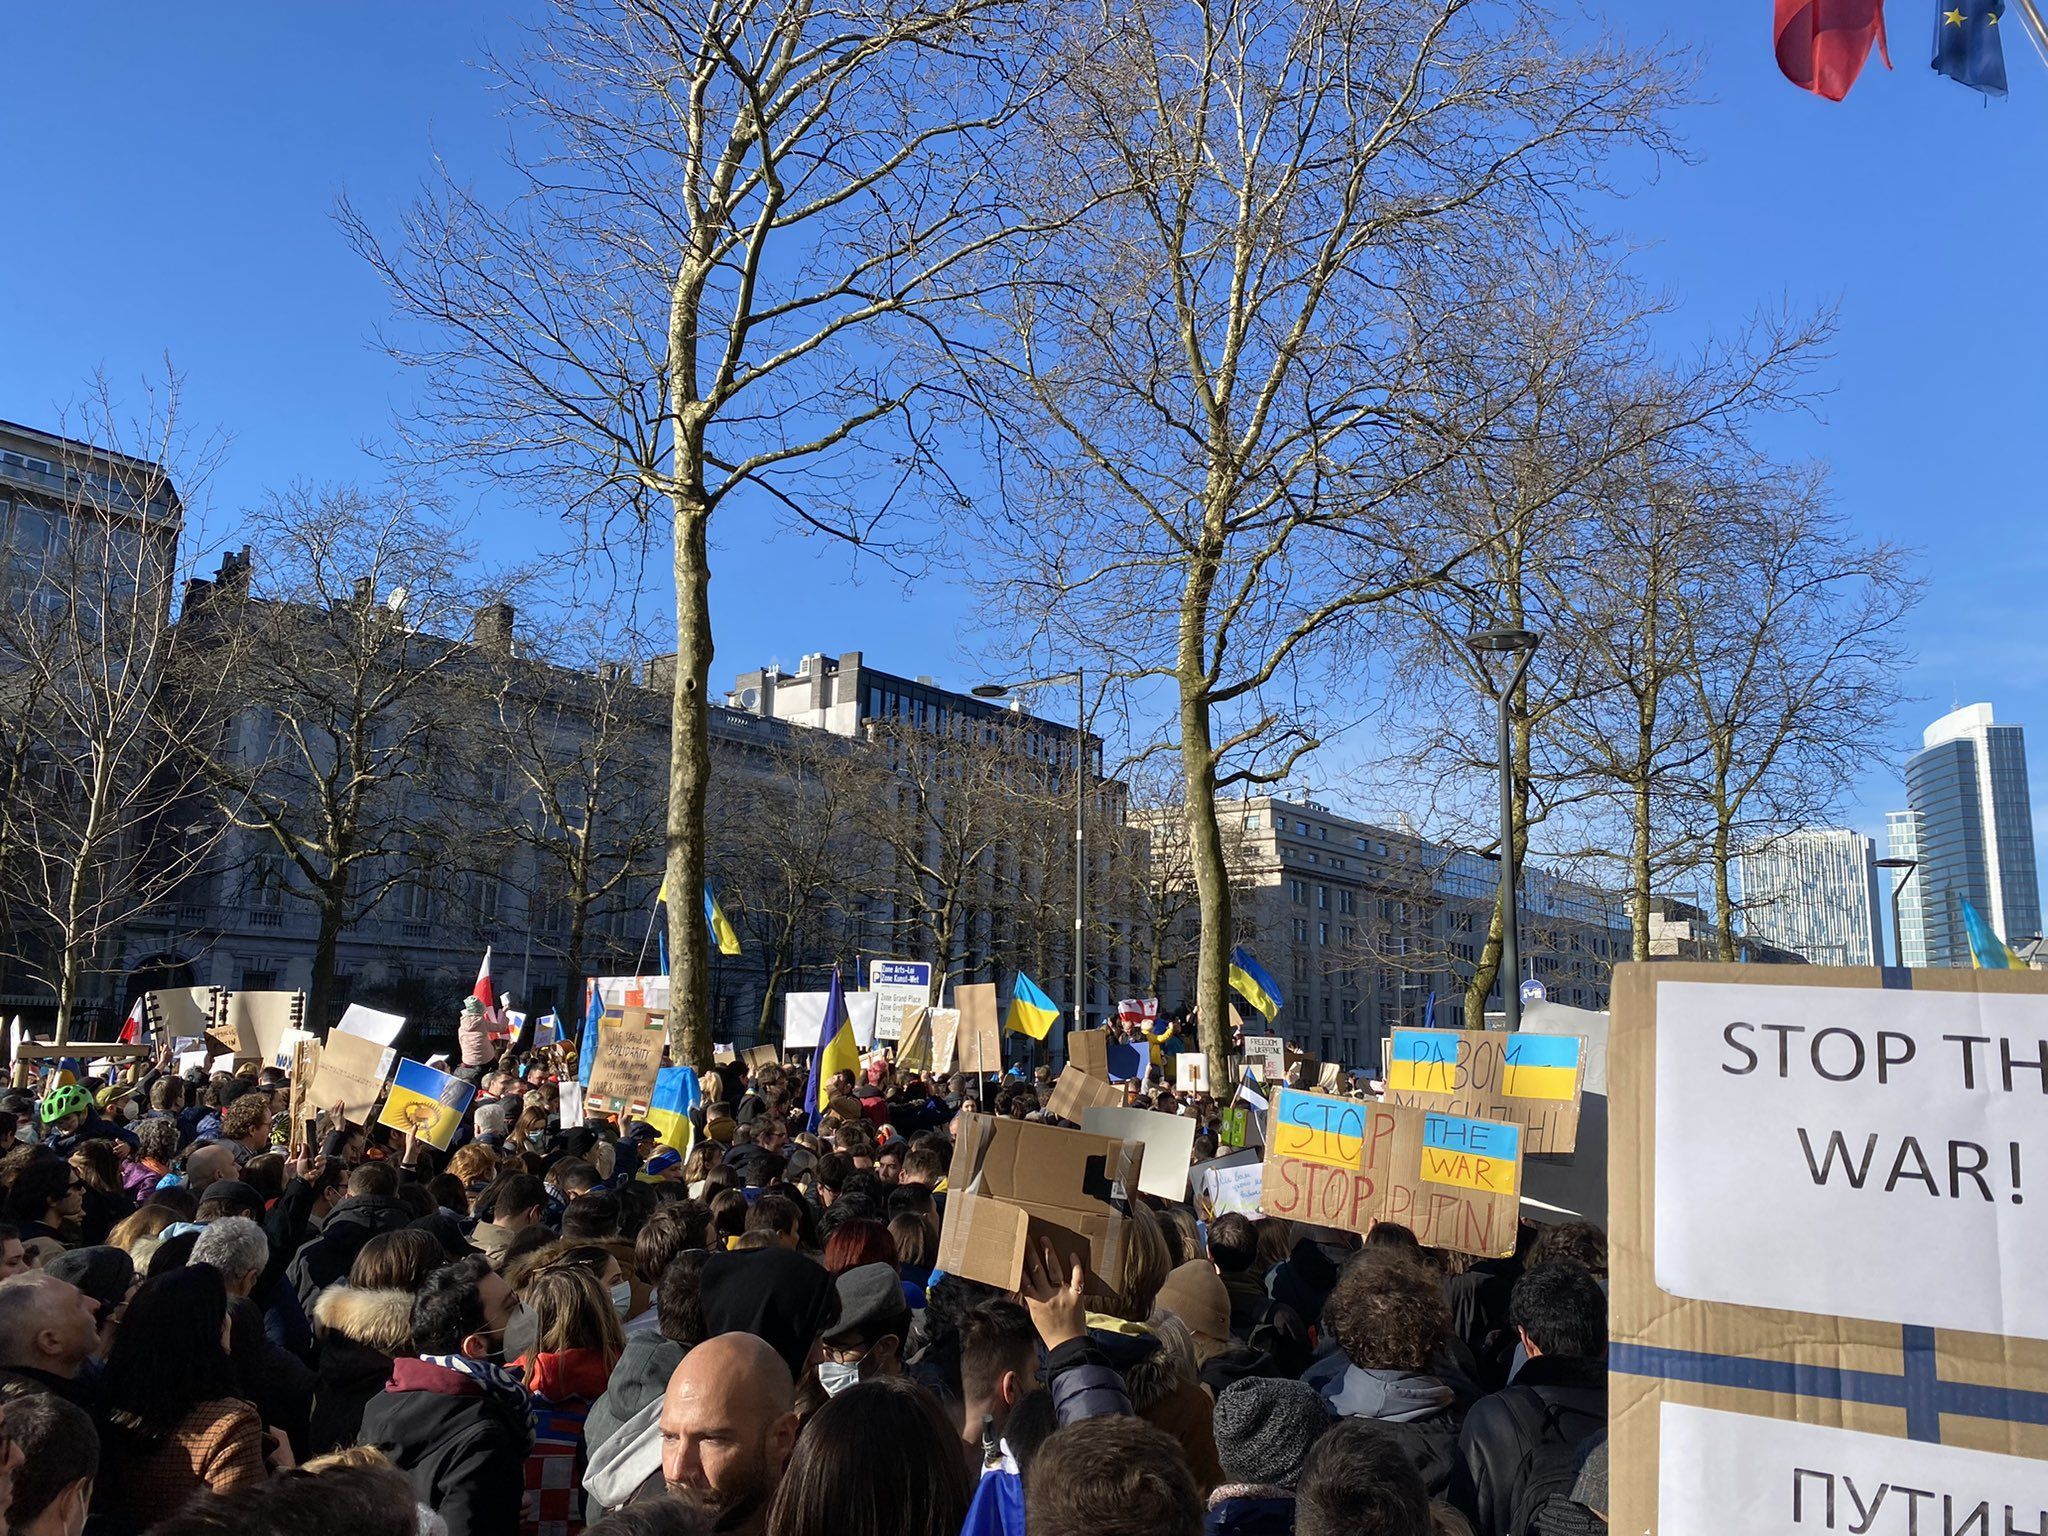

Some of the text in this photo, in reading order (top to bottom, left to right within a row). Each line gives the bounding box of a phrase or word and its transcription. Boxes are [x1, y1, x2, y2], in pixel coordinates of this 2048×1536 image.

[881, 965, 915, 975] Zone Arts-Loi
[881, 973, 920, 983] Zone Kunst-Wet
[880, 993, 921, 1003] Zone Grand Place
[880, 1003, 892, 1011] Zone
[879, 1014, 891, 1023] Zone
[879, 1028, 891, 1036] Zone
[1250, 1038, 1278, 1046] FREEDOM
[608, 1043, 651, 1060] SOLIDARITY
[1254, 1046, 1281, 1055] UKRAINE
[1721, 1020, 1917, 1085] STOP
[1291, 1102, 1396, 1169] STOP
[1425, 1117, 1491, 1151] THE
[1428, 1149, 1495, 1188] WAR
[1796, 1127, 2024, 1205] WAR!
[1274, 1159, 1375, 1226] STOP
[1389, 1184, 1493, 1253] PUTIN
